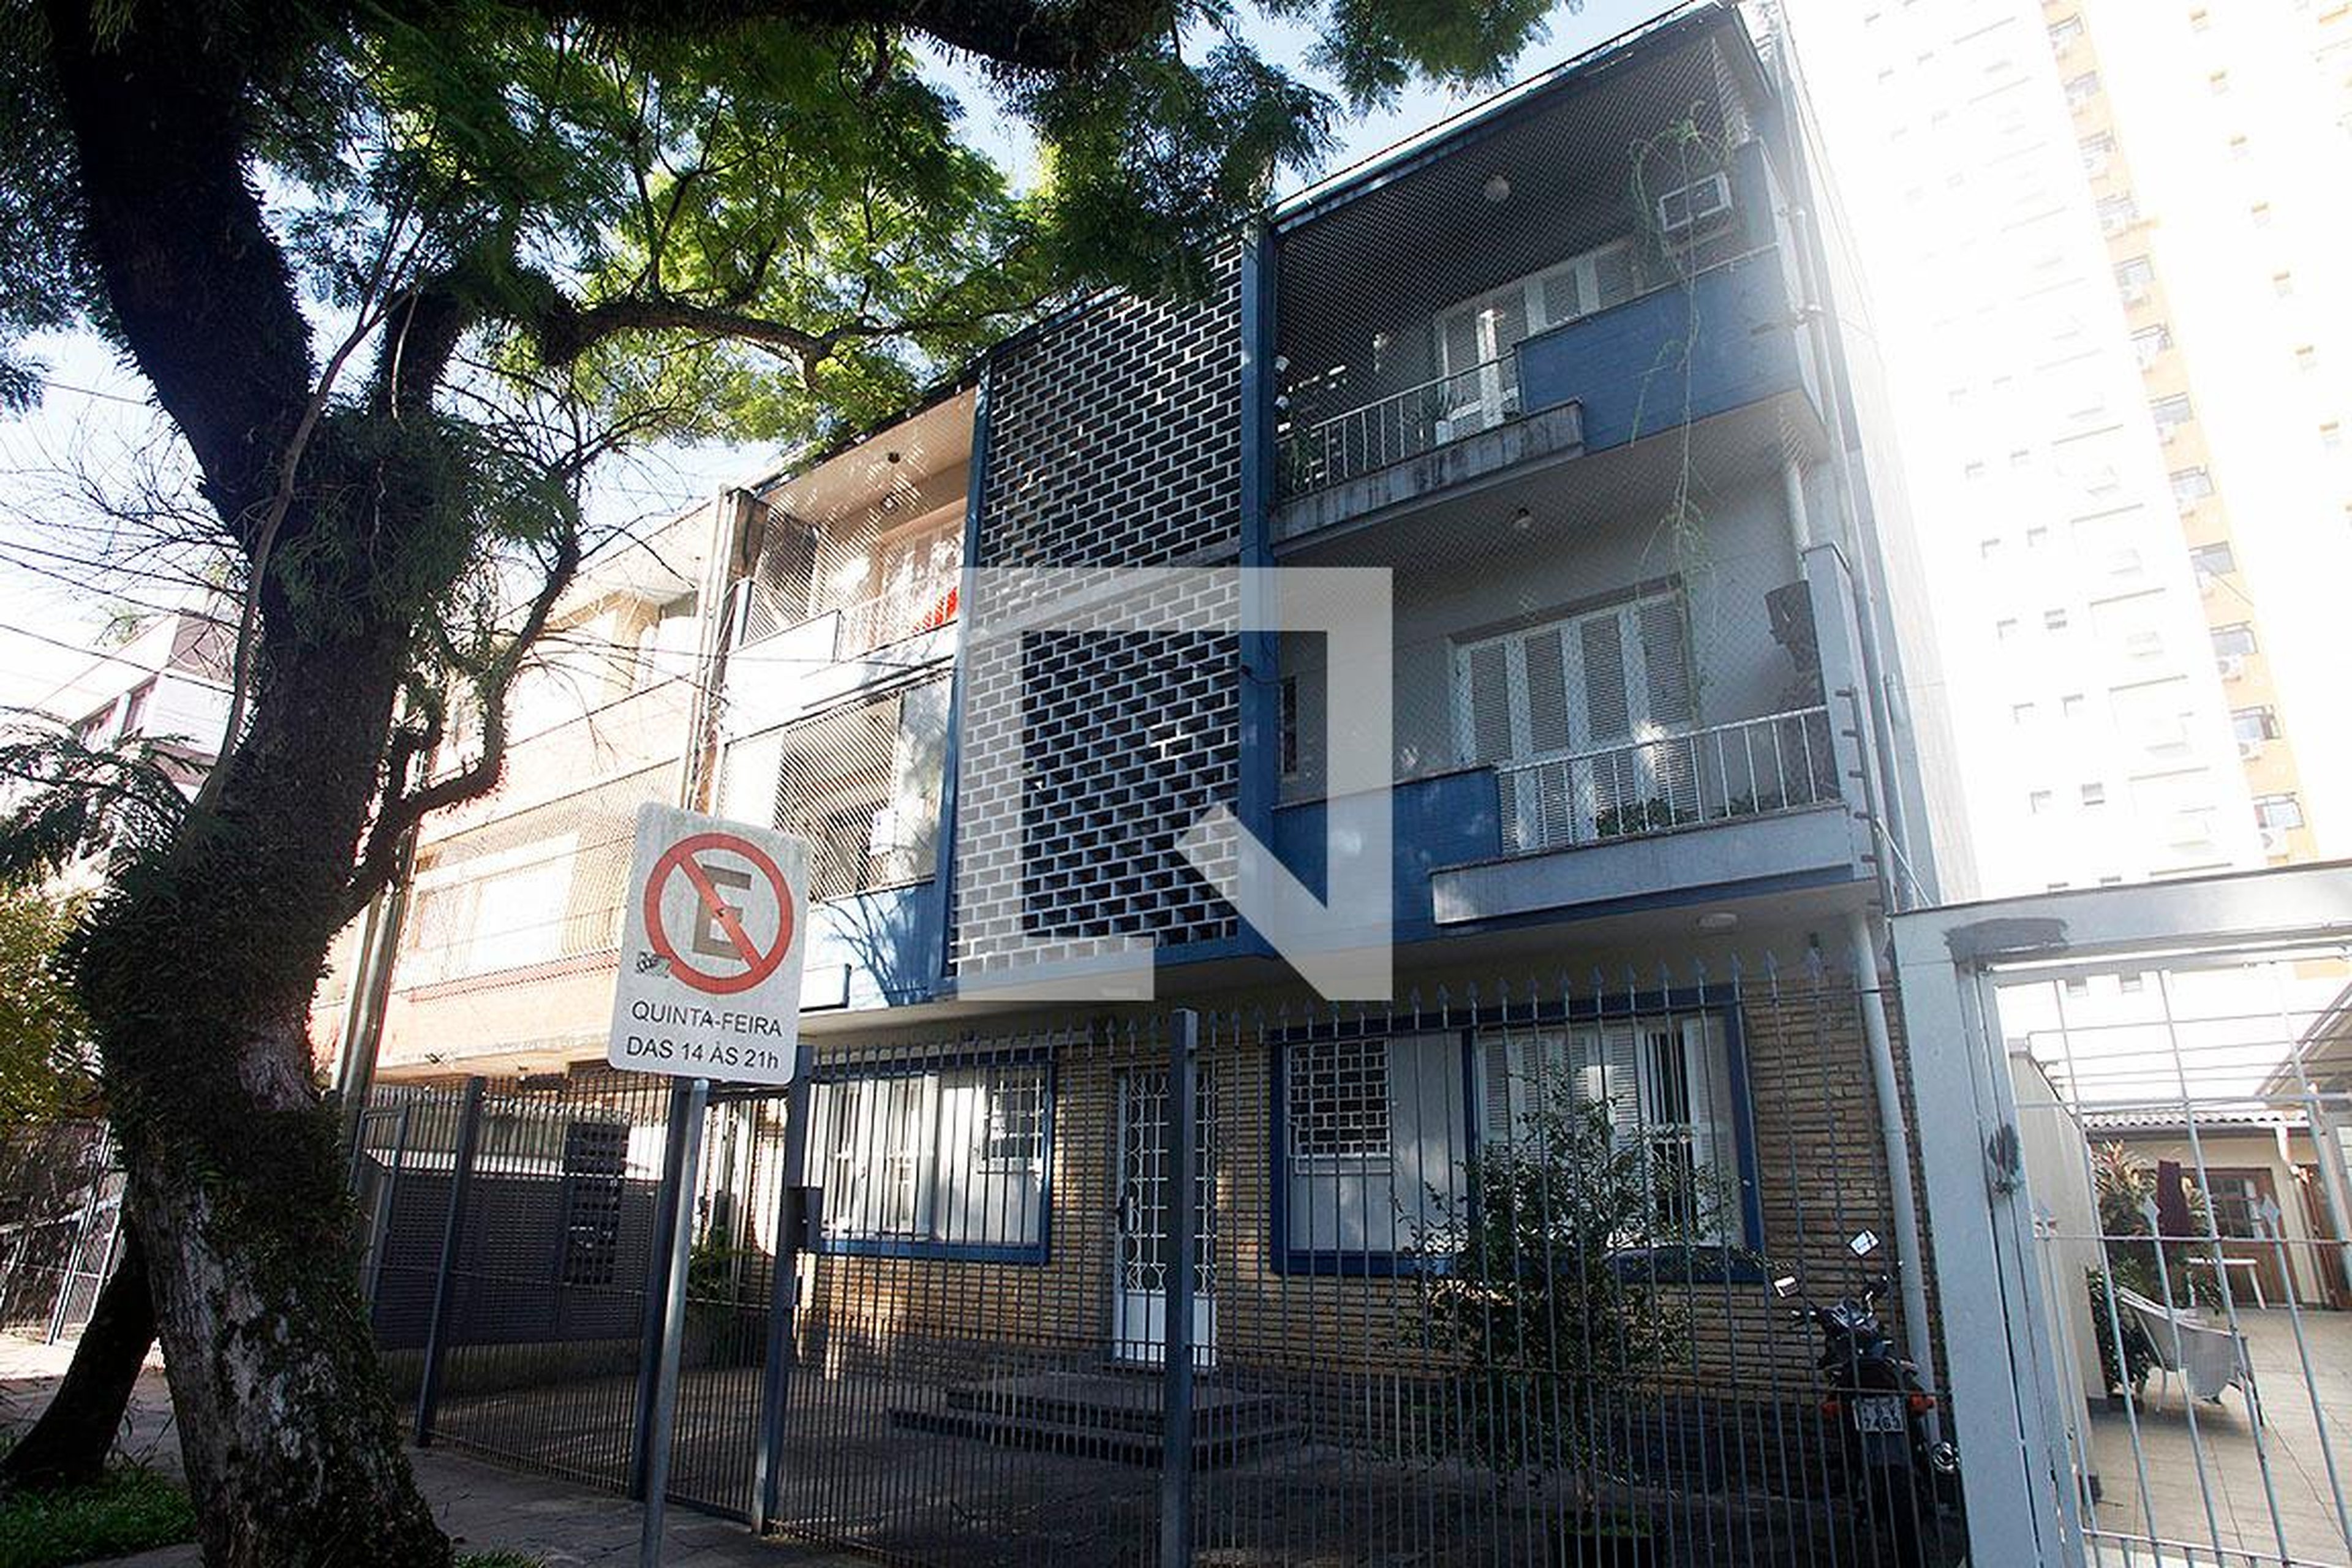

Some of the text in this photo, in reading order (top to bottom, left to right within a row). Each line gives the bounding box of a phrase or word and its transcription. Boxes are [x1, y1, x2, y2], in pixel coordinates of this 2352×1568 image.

[694, 864, 752, 961] E
[631, 1001, 782, 1037] QUINTA-FEIRA
[627, 1037, 673, 1059] DAS
[681, 1043, 704, 1062] 14
[744, 1049, 779, 1069] 21h
